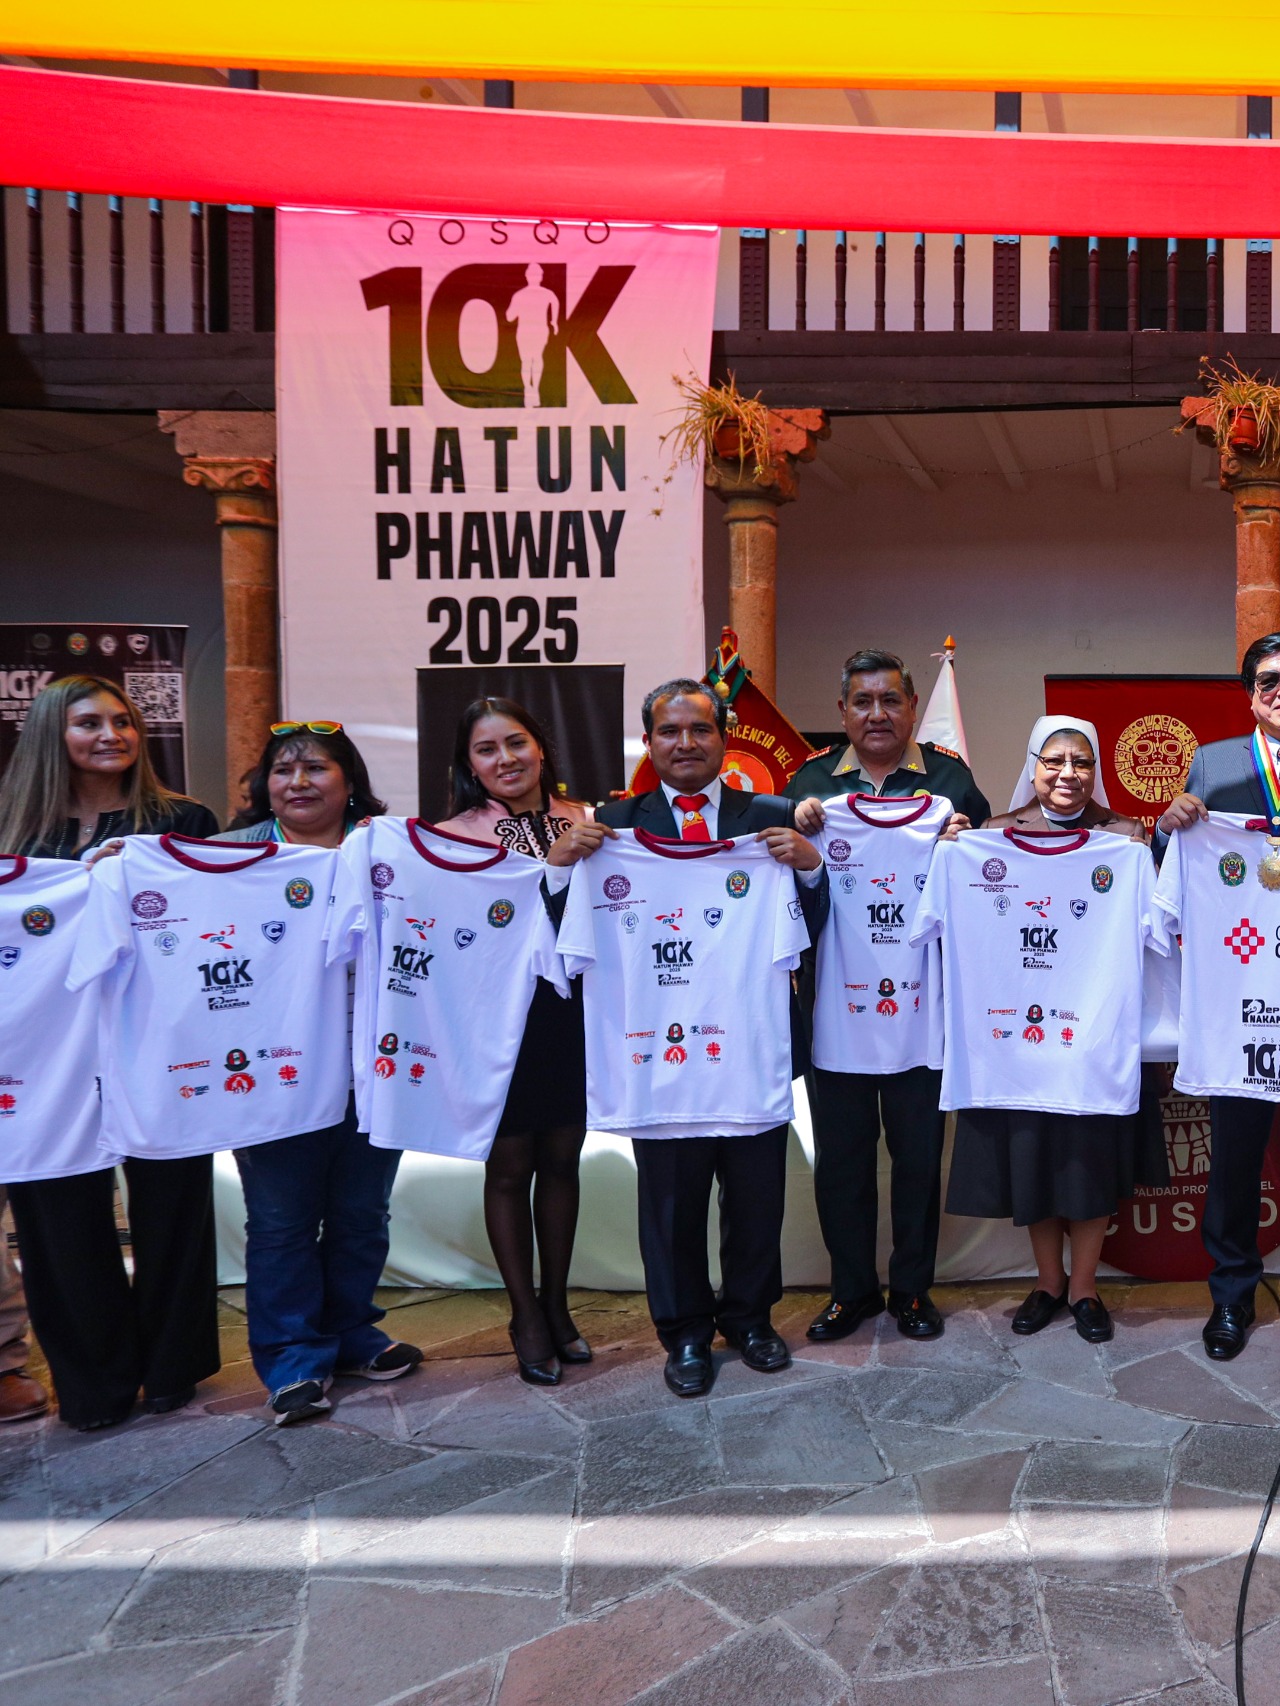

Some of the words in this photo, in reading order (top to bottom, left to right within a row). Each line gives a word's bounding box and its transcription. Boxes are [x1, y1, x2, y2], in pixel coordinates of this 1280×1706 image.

[388, 220, 610, 246] QOSQO
[359, 262, 638, 409] 10K
[374, 425, 626, 494] HATUN
[375, 510, 626, 580] PHAWAY
[427, 596, 579, 665] 2025
[773, 745, 793, 770] DEL
[609, 904, 630, 912] CUSCO
[867, 903, 905, 924] 10K
[1020, 927, 1058, 949] 10K
[393, 945, 435, 976] 10K
[651, 940, 694, 964] 10K
[197, 959, 254, 987] 10K
[1243, 1077, 1267, 1085] HATUN
[1182, 1185, 1208, 1195] PRO
